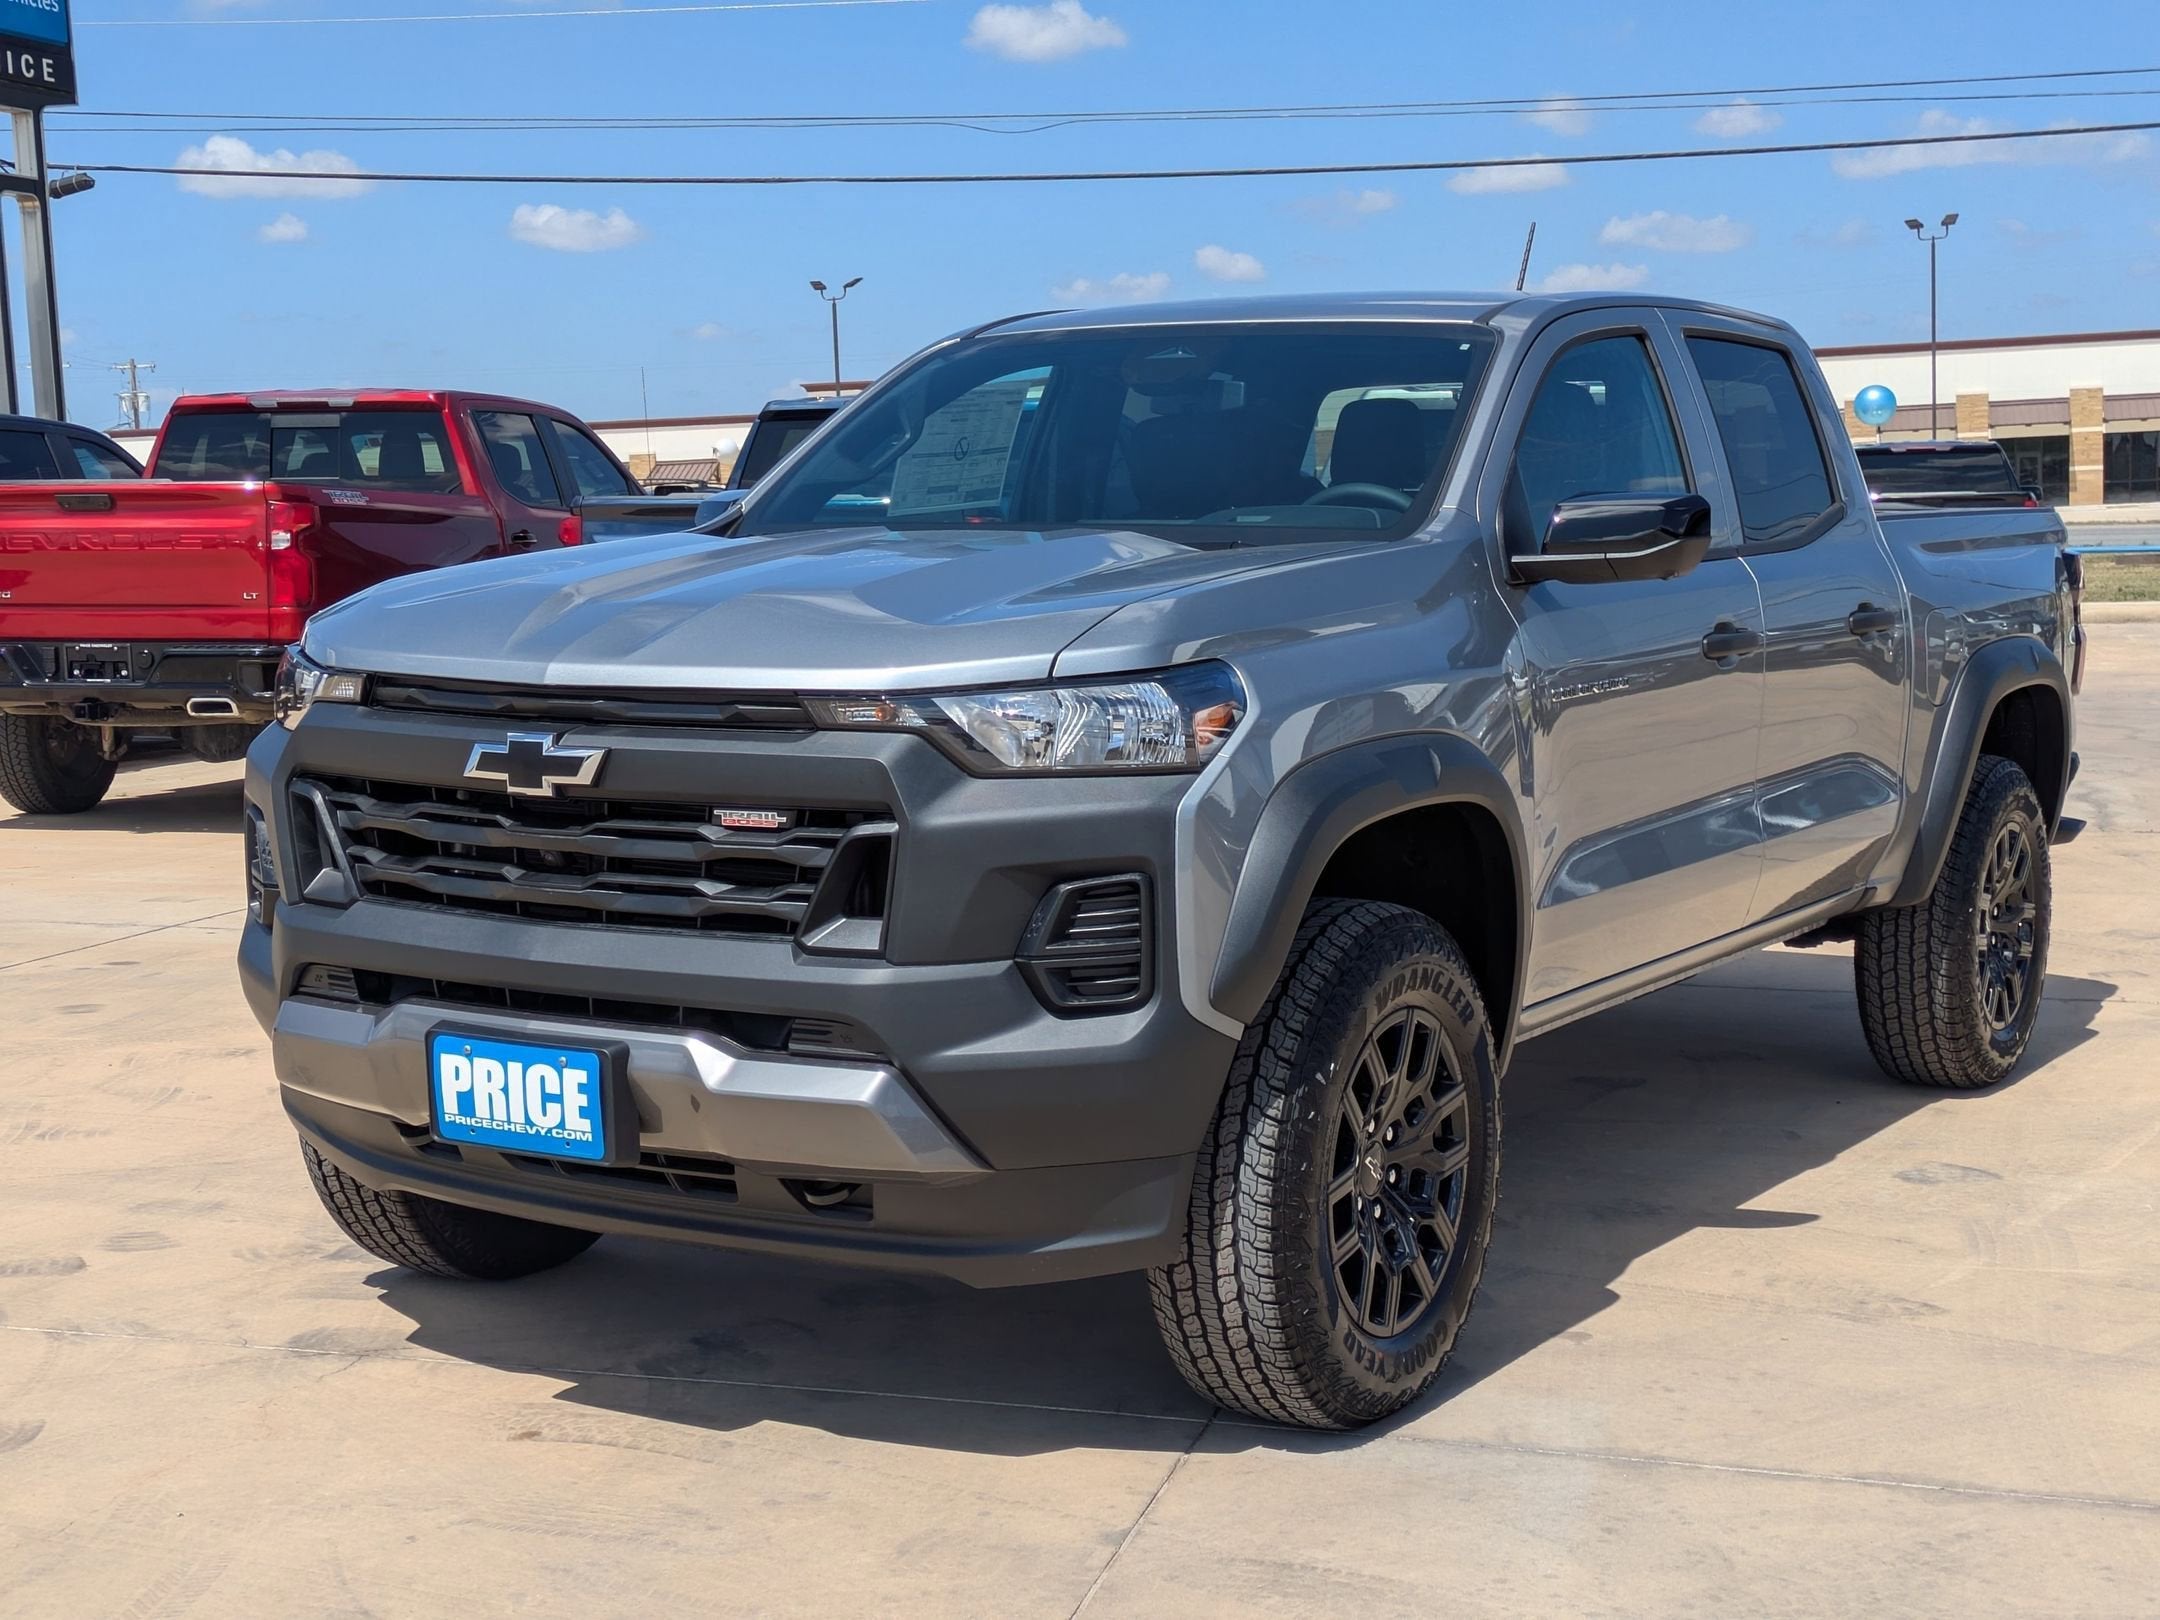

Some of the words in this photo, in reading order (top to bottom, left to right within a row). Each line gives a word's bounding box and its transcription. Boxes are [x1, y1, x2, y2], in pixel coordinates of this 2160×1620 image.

[0, 534, 246, 550] EVROLET
[243, 591, 259, 600] LT
[714, 809, 787, 823] TRAIL
[721, 818, 778, 828] BOSS
[1375, 967, 1474, 1028] WRANGLER
[440, 1053, 592, 1132] PRICE
[444, 1113, 592, 1142] PRICECHEVY.COM
